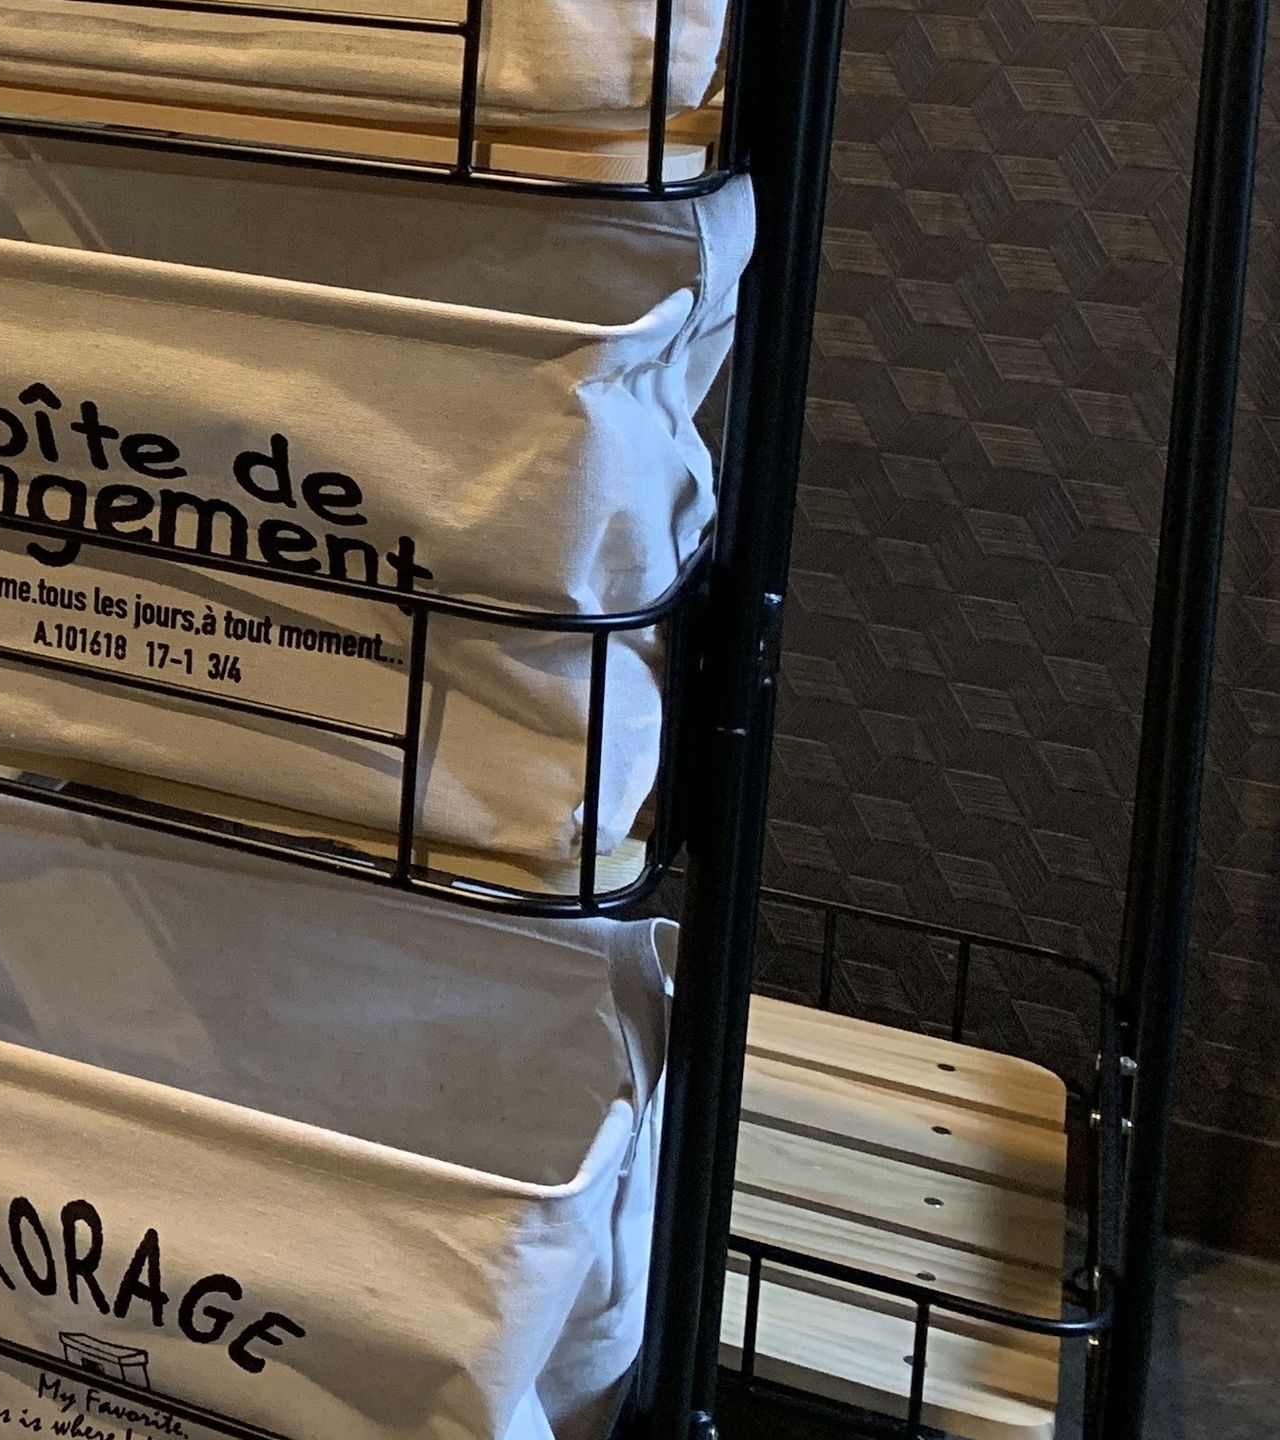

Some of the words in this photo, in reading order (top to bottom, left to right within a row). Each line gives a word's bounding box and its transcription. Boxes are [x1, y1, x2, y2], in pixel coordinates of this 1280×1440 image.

[232, 432, 369, 526] de
[93, 586, 130, 620] les
[223, 614, 272, 646] tout
[33, 621, 129, 661] A.101618
[145, 641, 195, 676] 17-1
[207, 652, 243, 685] 3/4
[19, 1410, 41, 1433] is
[39, 1373, 76, 1412] My
[86, 1388, 189, 1440] Favorite.
